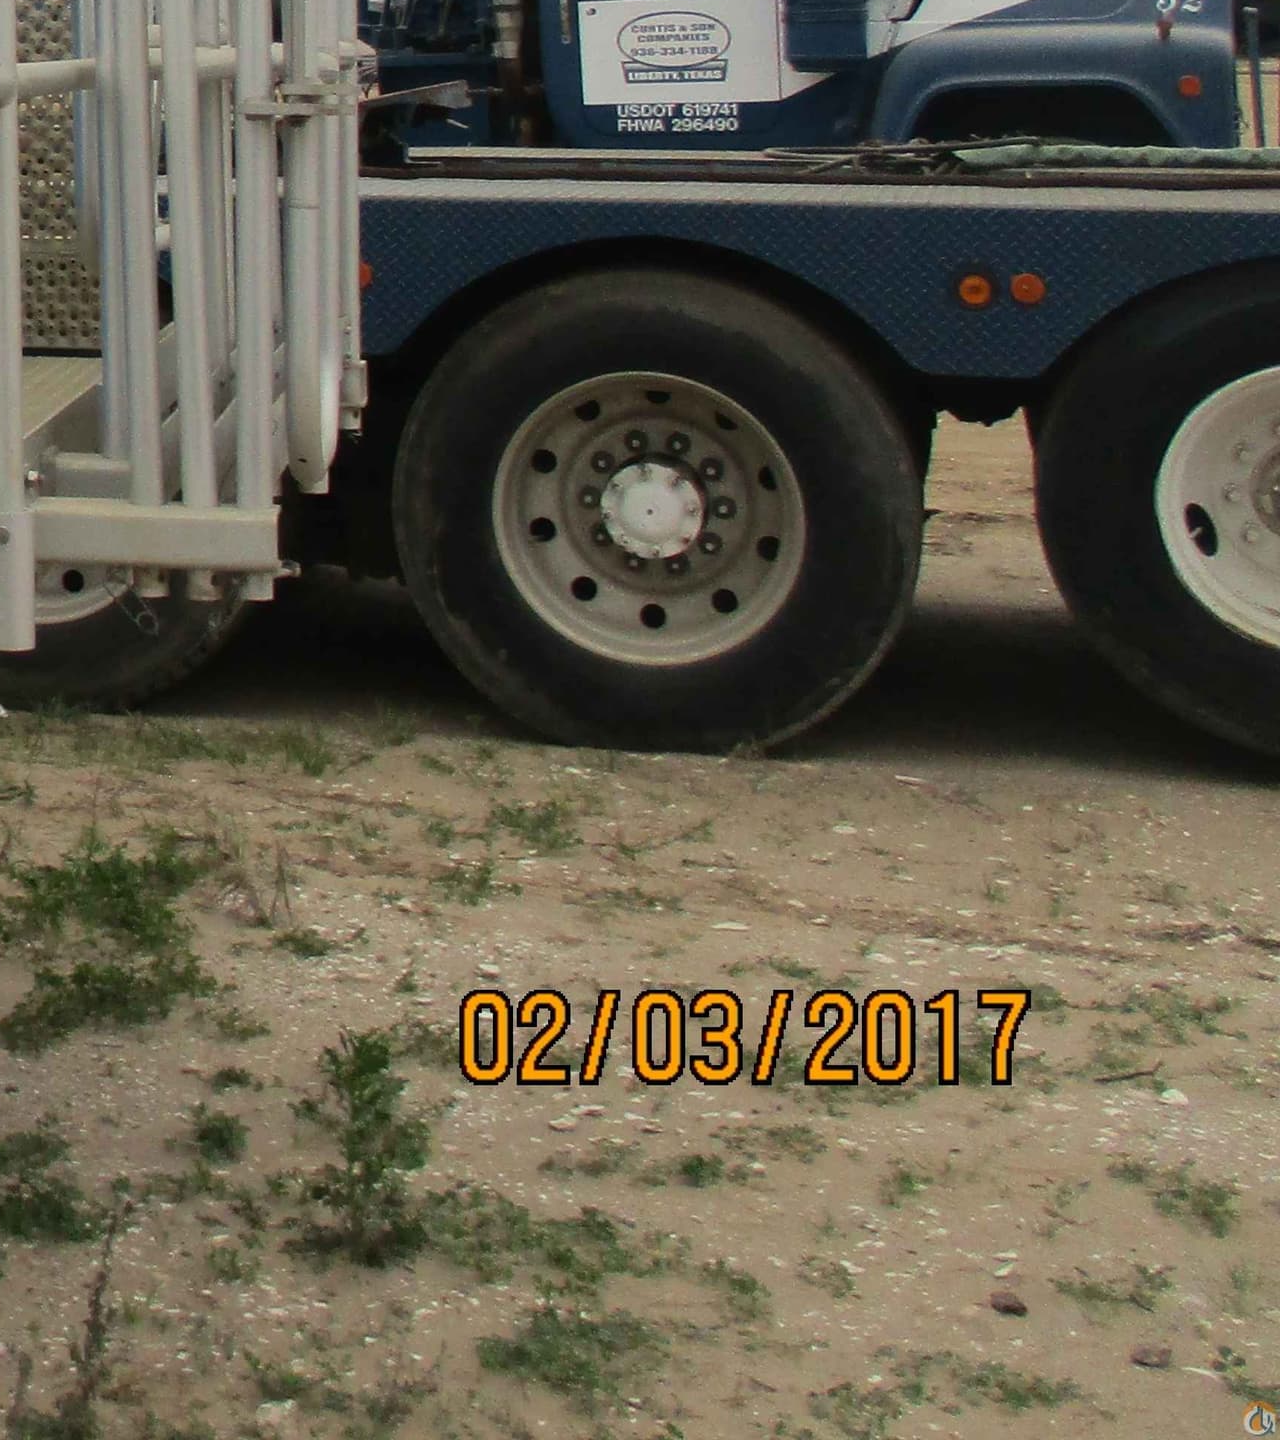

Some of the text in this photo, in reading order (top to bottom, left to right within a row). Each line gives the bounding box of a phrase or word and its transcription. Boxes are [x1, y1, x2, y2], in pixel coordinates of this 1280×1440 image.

[631, 24, 676, 33] CURTIS
[690, 23, 716, 32] SON
[637, 33, 710, 43] COMPANIES
[684, 70, 722, 79] TEXAS
[617, 104, 738, 117] USDOT 619741
[617, 118, 738, 131] FHWA 296490
